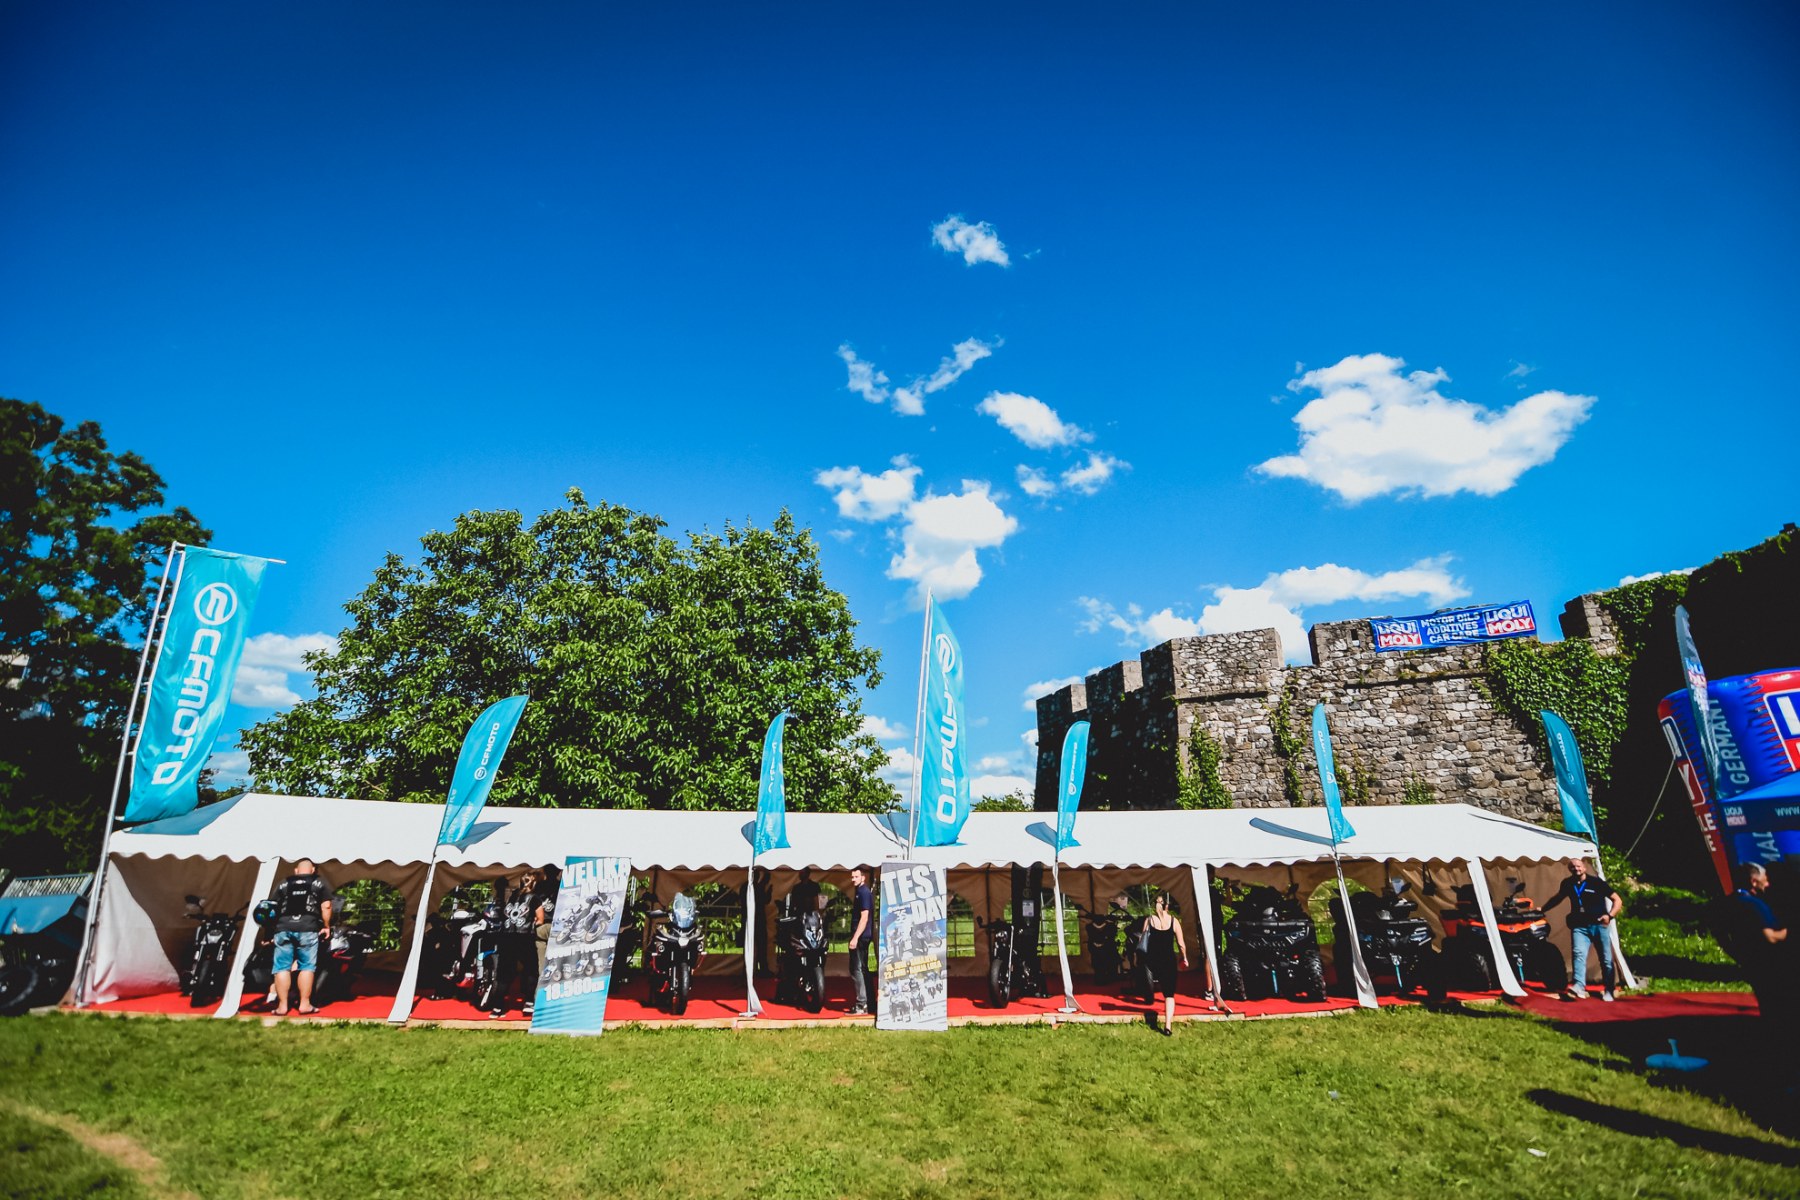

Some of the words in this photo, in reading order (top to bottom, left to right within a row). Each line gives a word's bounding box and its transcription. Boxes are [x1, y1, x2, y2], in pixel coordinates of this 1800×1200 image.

[1421, 615, 1455, 628] MOTOR
[1457, 611, 1481, 623] OILS
[1485, 605, 1528, 622] LIQUI
[1377, 620, 1417, 635] LIQUI
[1426, 621, 1479, 636] ADDITIVES
[1488, 618, 1532, 635] MOLY
[1379, 634, 1422, 648] MOLY
[1429, 634, 1451, 644] CAR
[1451, 630, 1480, 641] CARE
[151, 628, 222, 785] CFMOTO
[481, 722, 500, 766] CFMOTO
[880, 864, 947, 906] TEST
[910, 895, 947, 925] DAY
